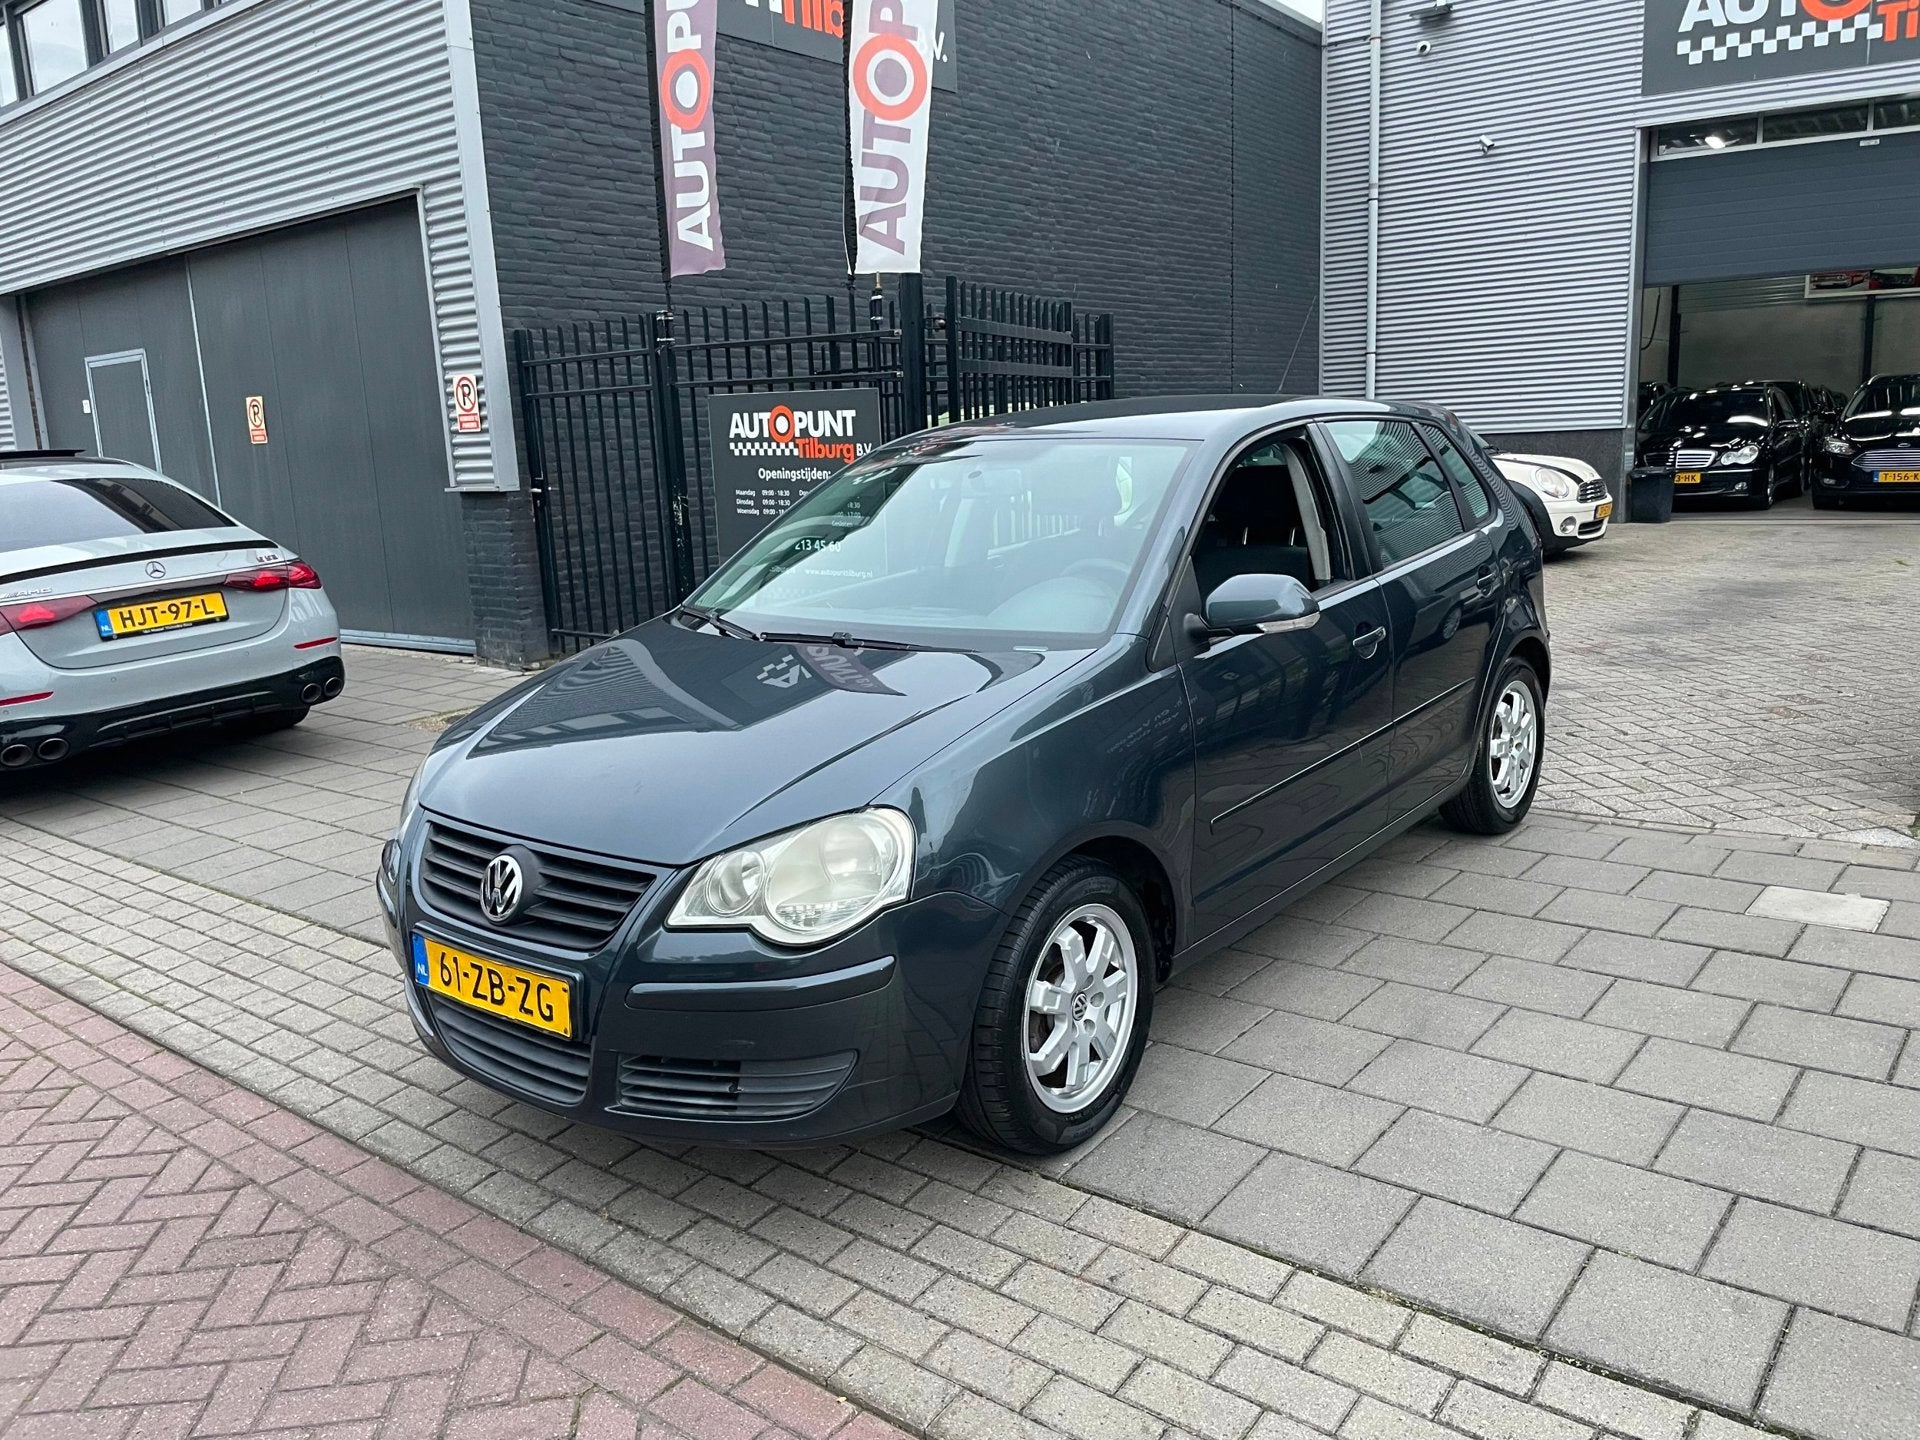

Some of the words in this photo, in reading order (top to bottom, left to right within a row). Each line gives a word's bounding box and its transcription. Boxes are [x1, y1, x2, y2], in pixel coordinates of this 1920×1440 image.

[729, 404, 856, 443] AUTOPUNT
[796, 438, 855, 463] Tilburg
[119, 598, 215, 629] HJT-97-L
[417, 963, 428, 977] NL
[439, 951, 554, 1022] 61-ZB-ZG
